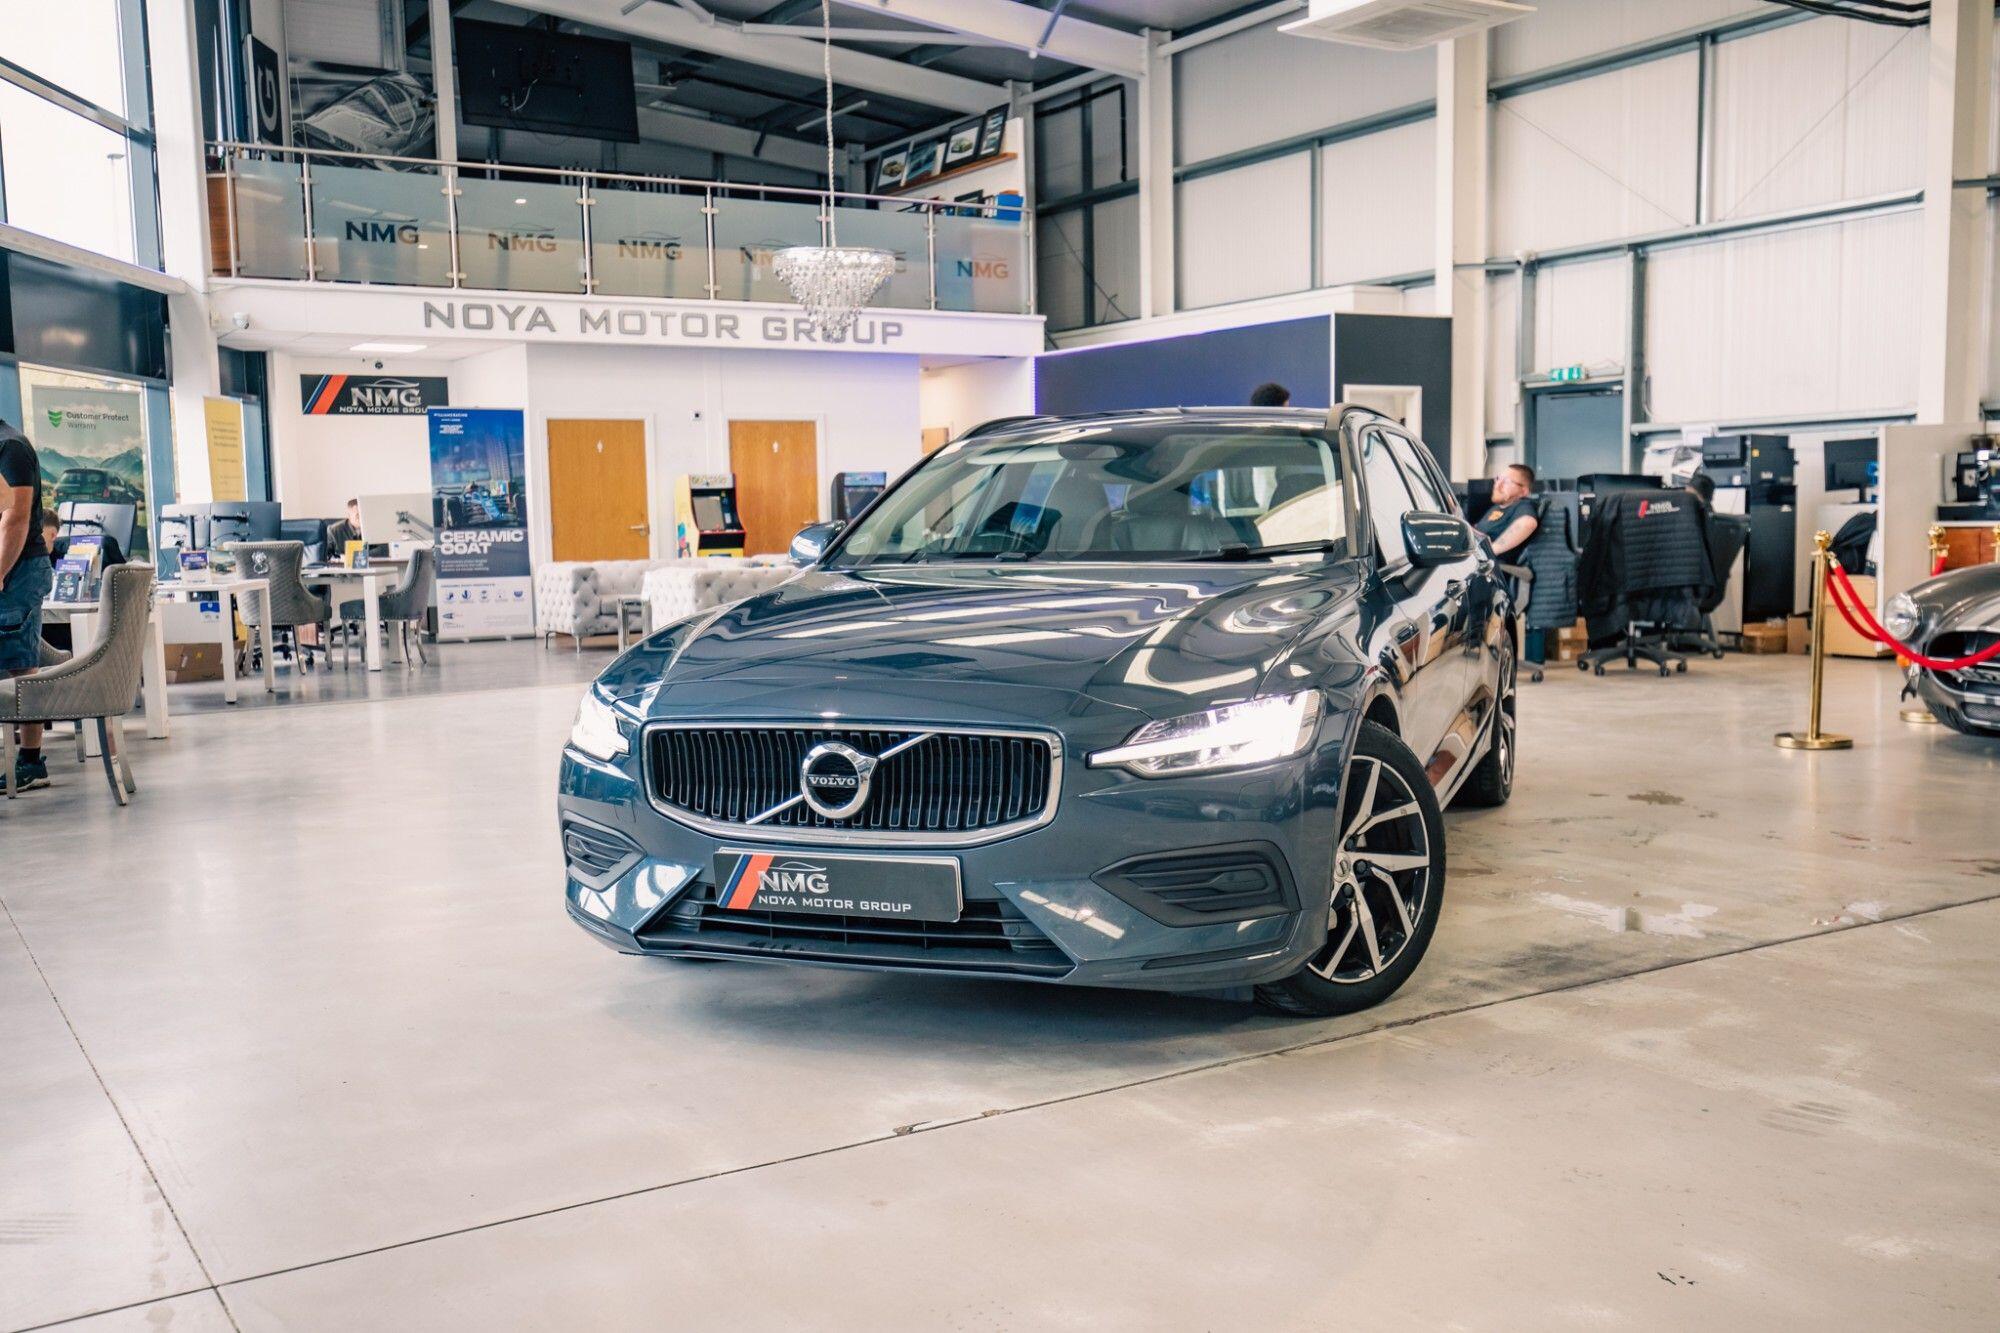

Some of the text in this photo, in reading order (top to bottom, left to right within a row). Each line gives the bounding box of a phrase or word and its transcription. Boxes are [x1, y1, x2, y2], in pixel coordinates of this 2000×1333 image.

[345, 220, 420, 245] NMG
[488, 232, 557, 252] NMG
[618, 239, 684, 260] NMG
[740, 246, 774, 267] NM
[957, 260, 1009, 279] NMG
[423, 301, 557, 332] NOYA
[579, 307, 740, 339] MOTOR
[351, 387, 422, 407] NMG
[66, 411, 129, 422] Customer Protect
[367, 406, 399, 414] MOTOR
[440, 529, 524, 543] CERAMIC
[440, 542, 492, 555] COAT
[808, 776, 856, 786] VOLVO
[757, 870, 829, 894] NMG
[758, 895, 912, 913] NOYA MOTOR GROUP
